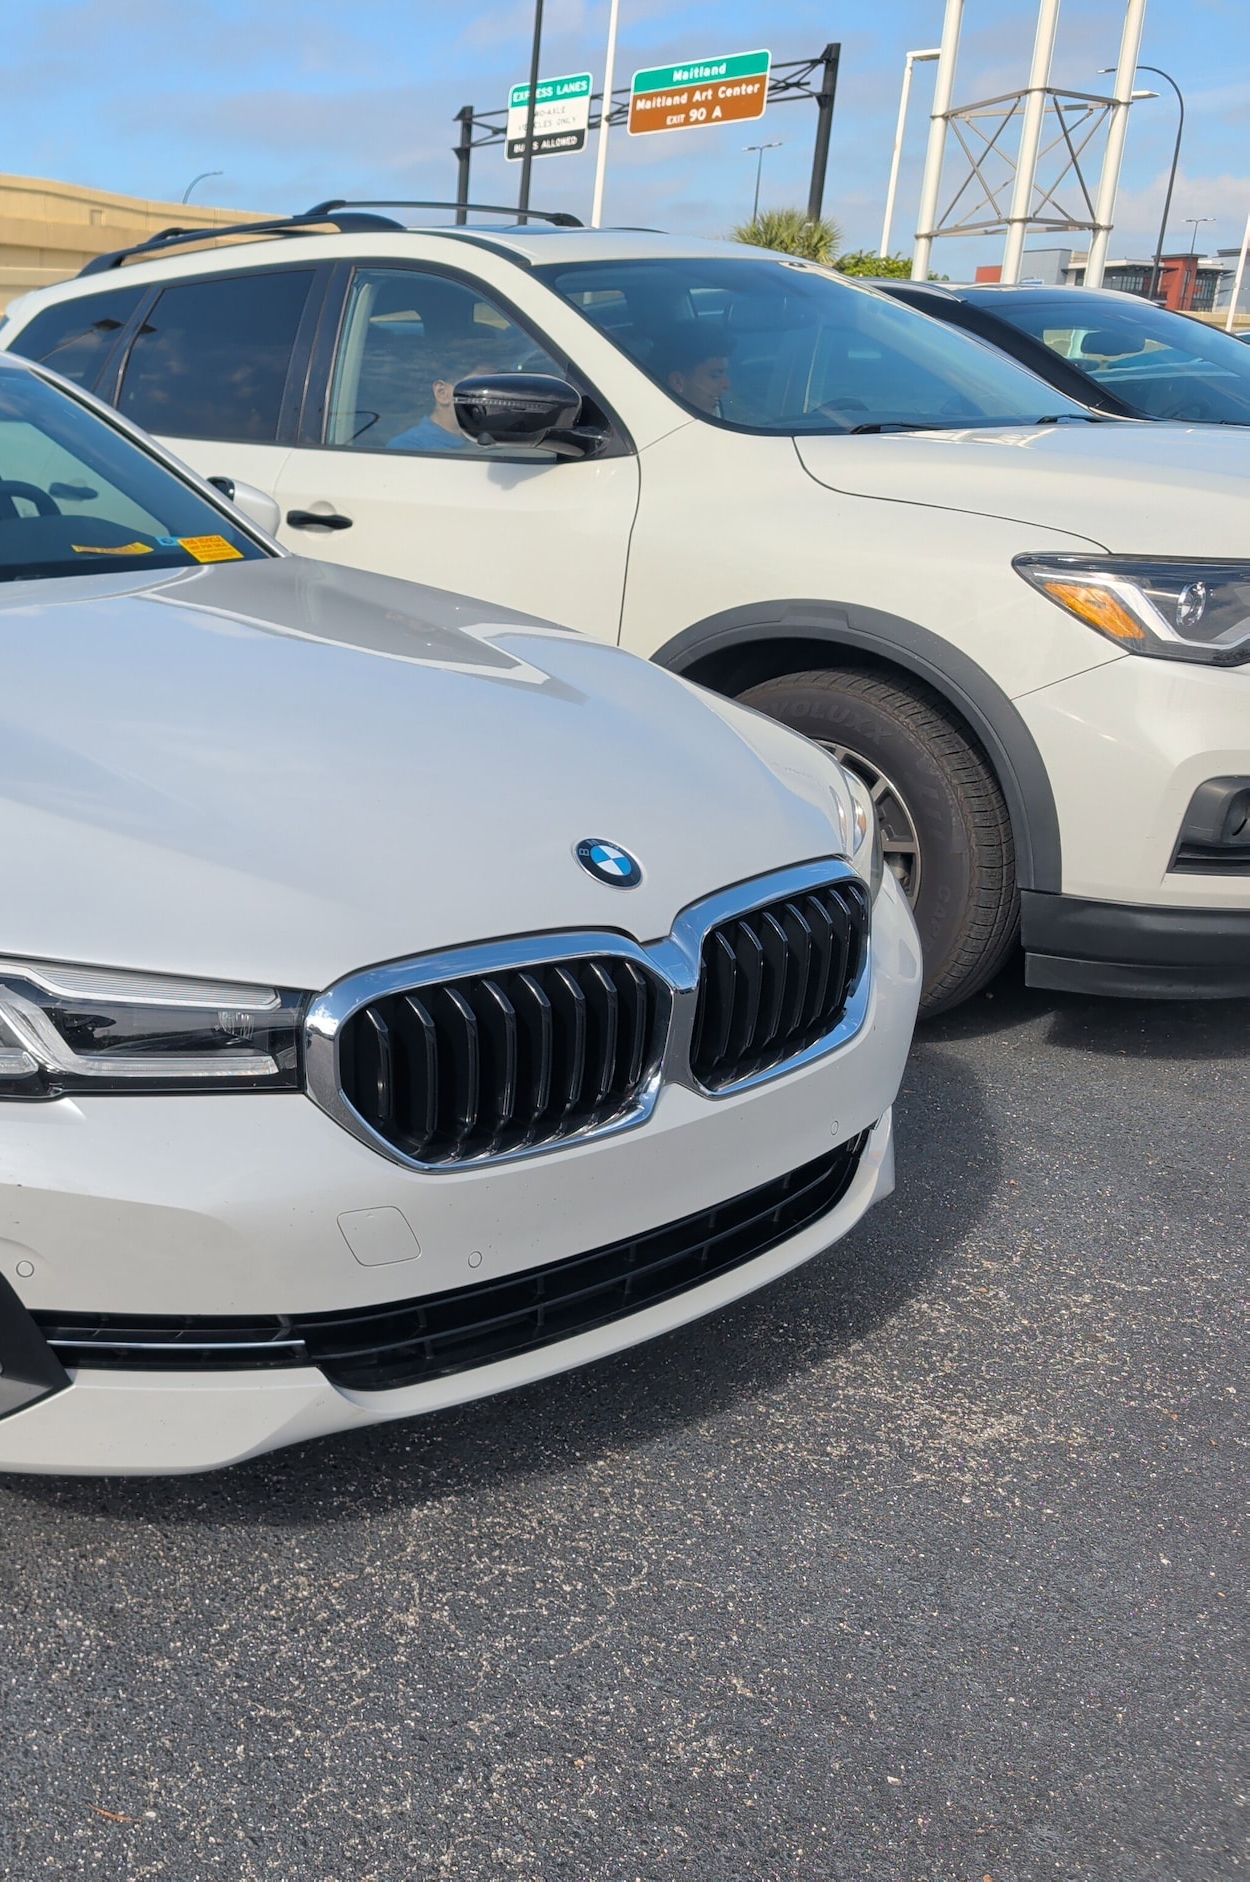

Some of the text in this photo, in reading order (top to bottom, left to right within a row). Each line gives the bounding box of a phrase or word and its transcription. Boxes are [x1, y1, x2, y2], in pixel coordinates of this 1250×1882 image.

[672, 62, 727, 82] Maitland
[513, 80, 588, 103] EXPESS LANES
[636, 83, 760, 111] Maitland Art Center
[666, 105, 722, 125] EXIT 90 A
[513, 136, 578, 153] BUS ALLOWED
